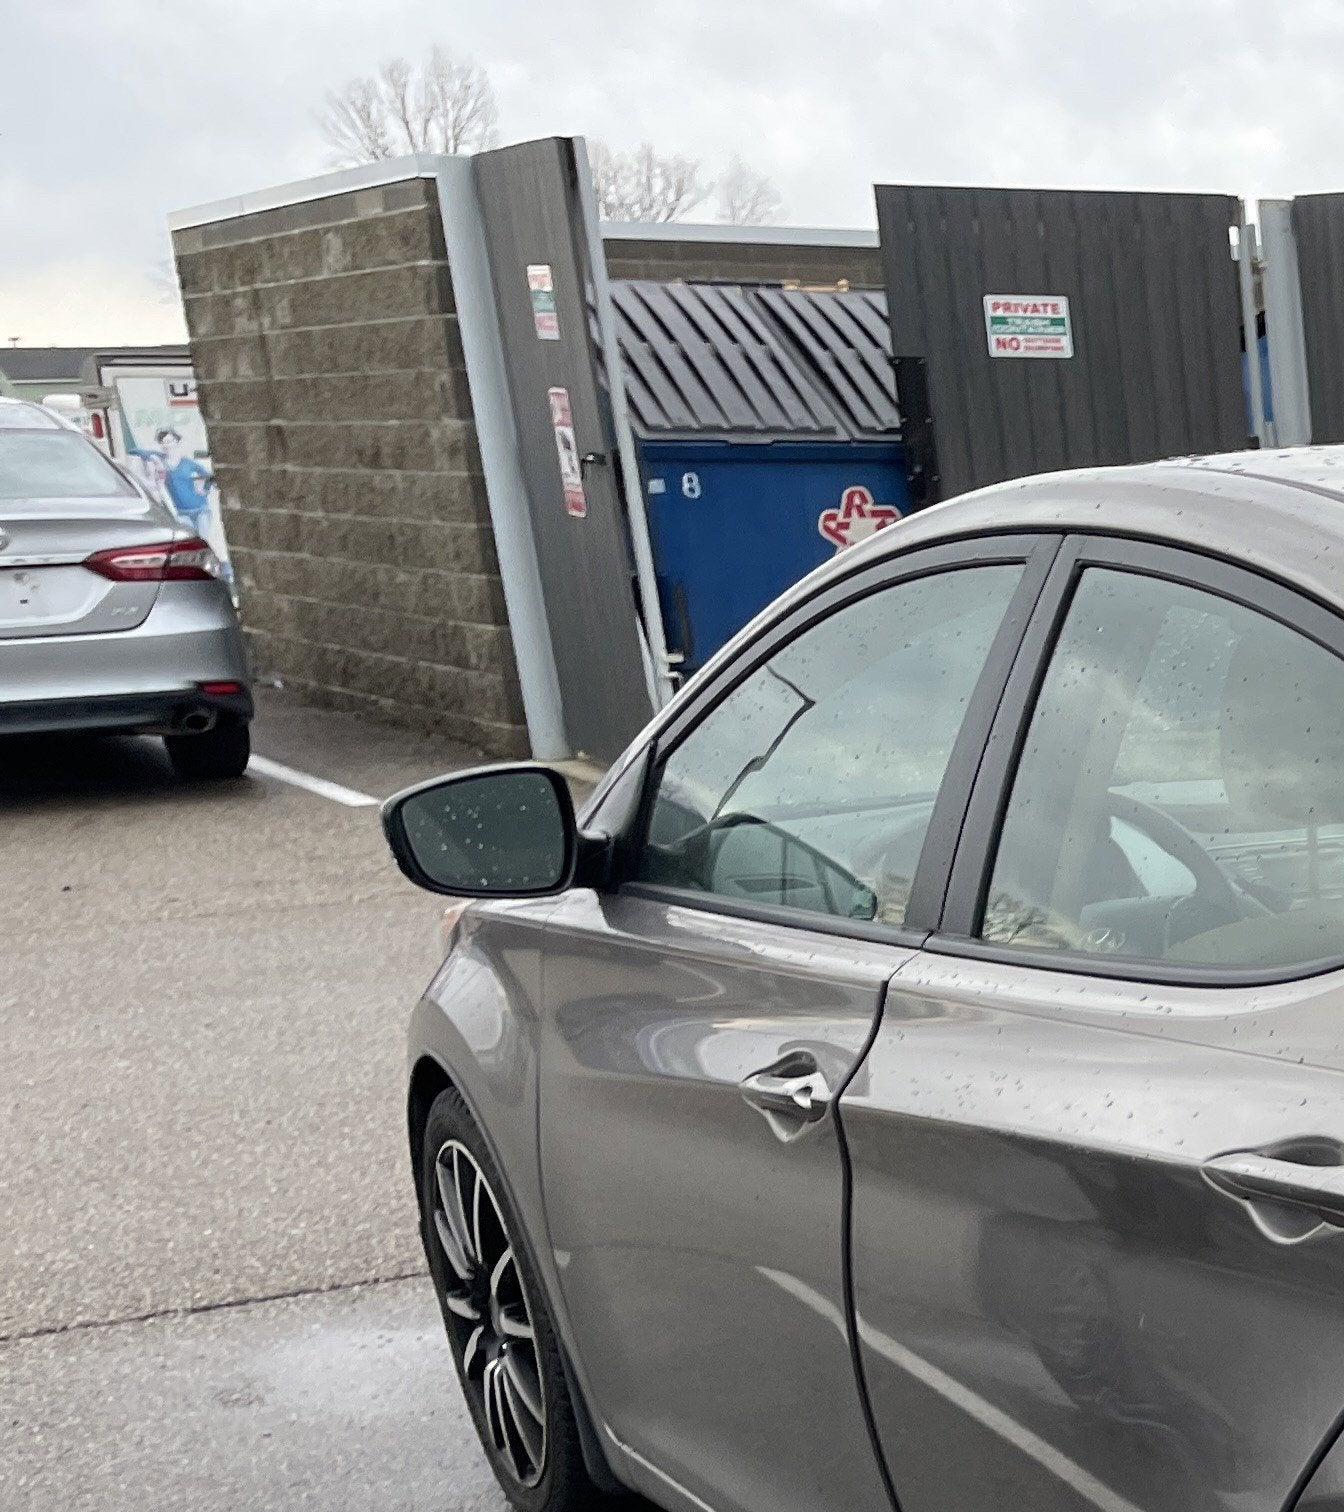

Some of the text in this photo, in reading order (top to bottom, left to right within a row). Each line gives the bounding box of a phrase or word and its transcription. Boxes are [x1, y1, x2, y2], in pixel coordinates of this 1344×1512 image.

[991, 301, 1061, 315] PRIVATE
[996, 337, 1021, 351] NO
[681, 471, 701, 499] 8
